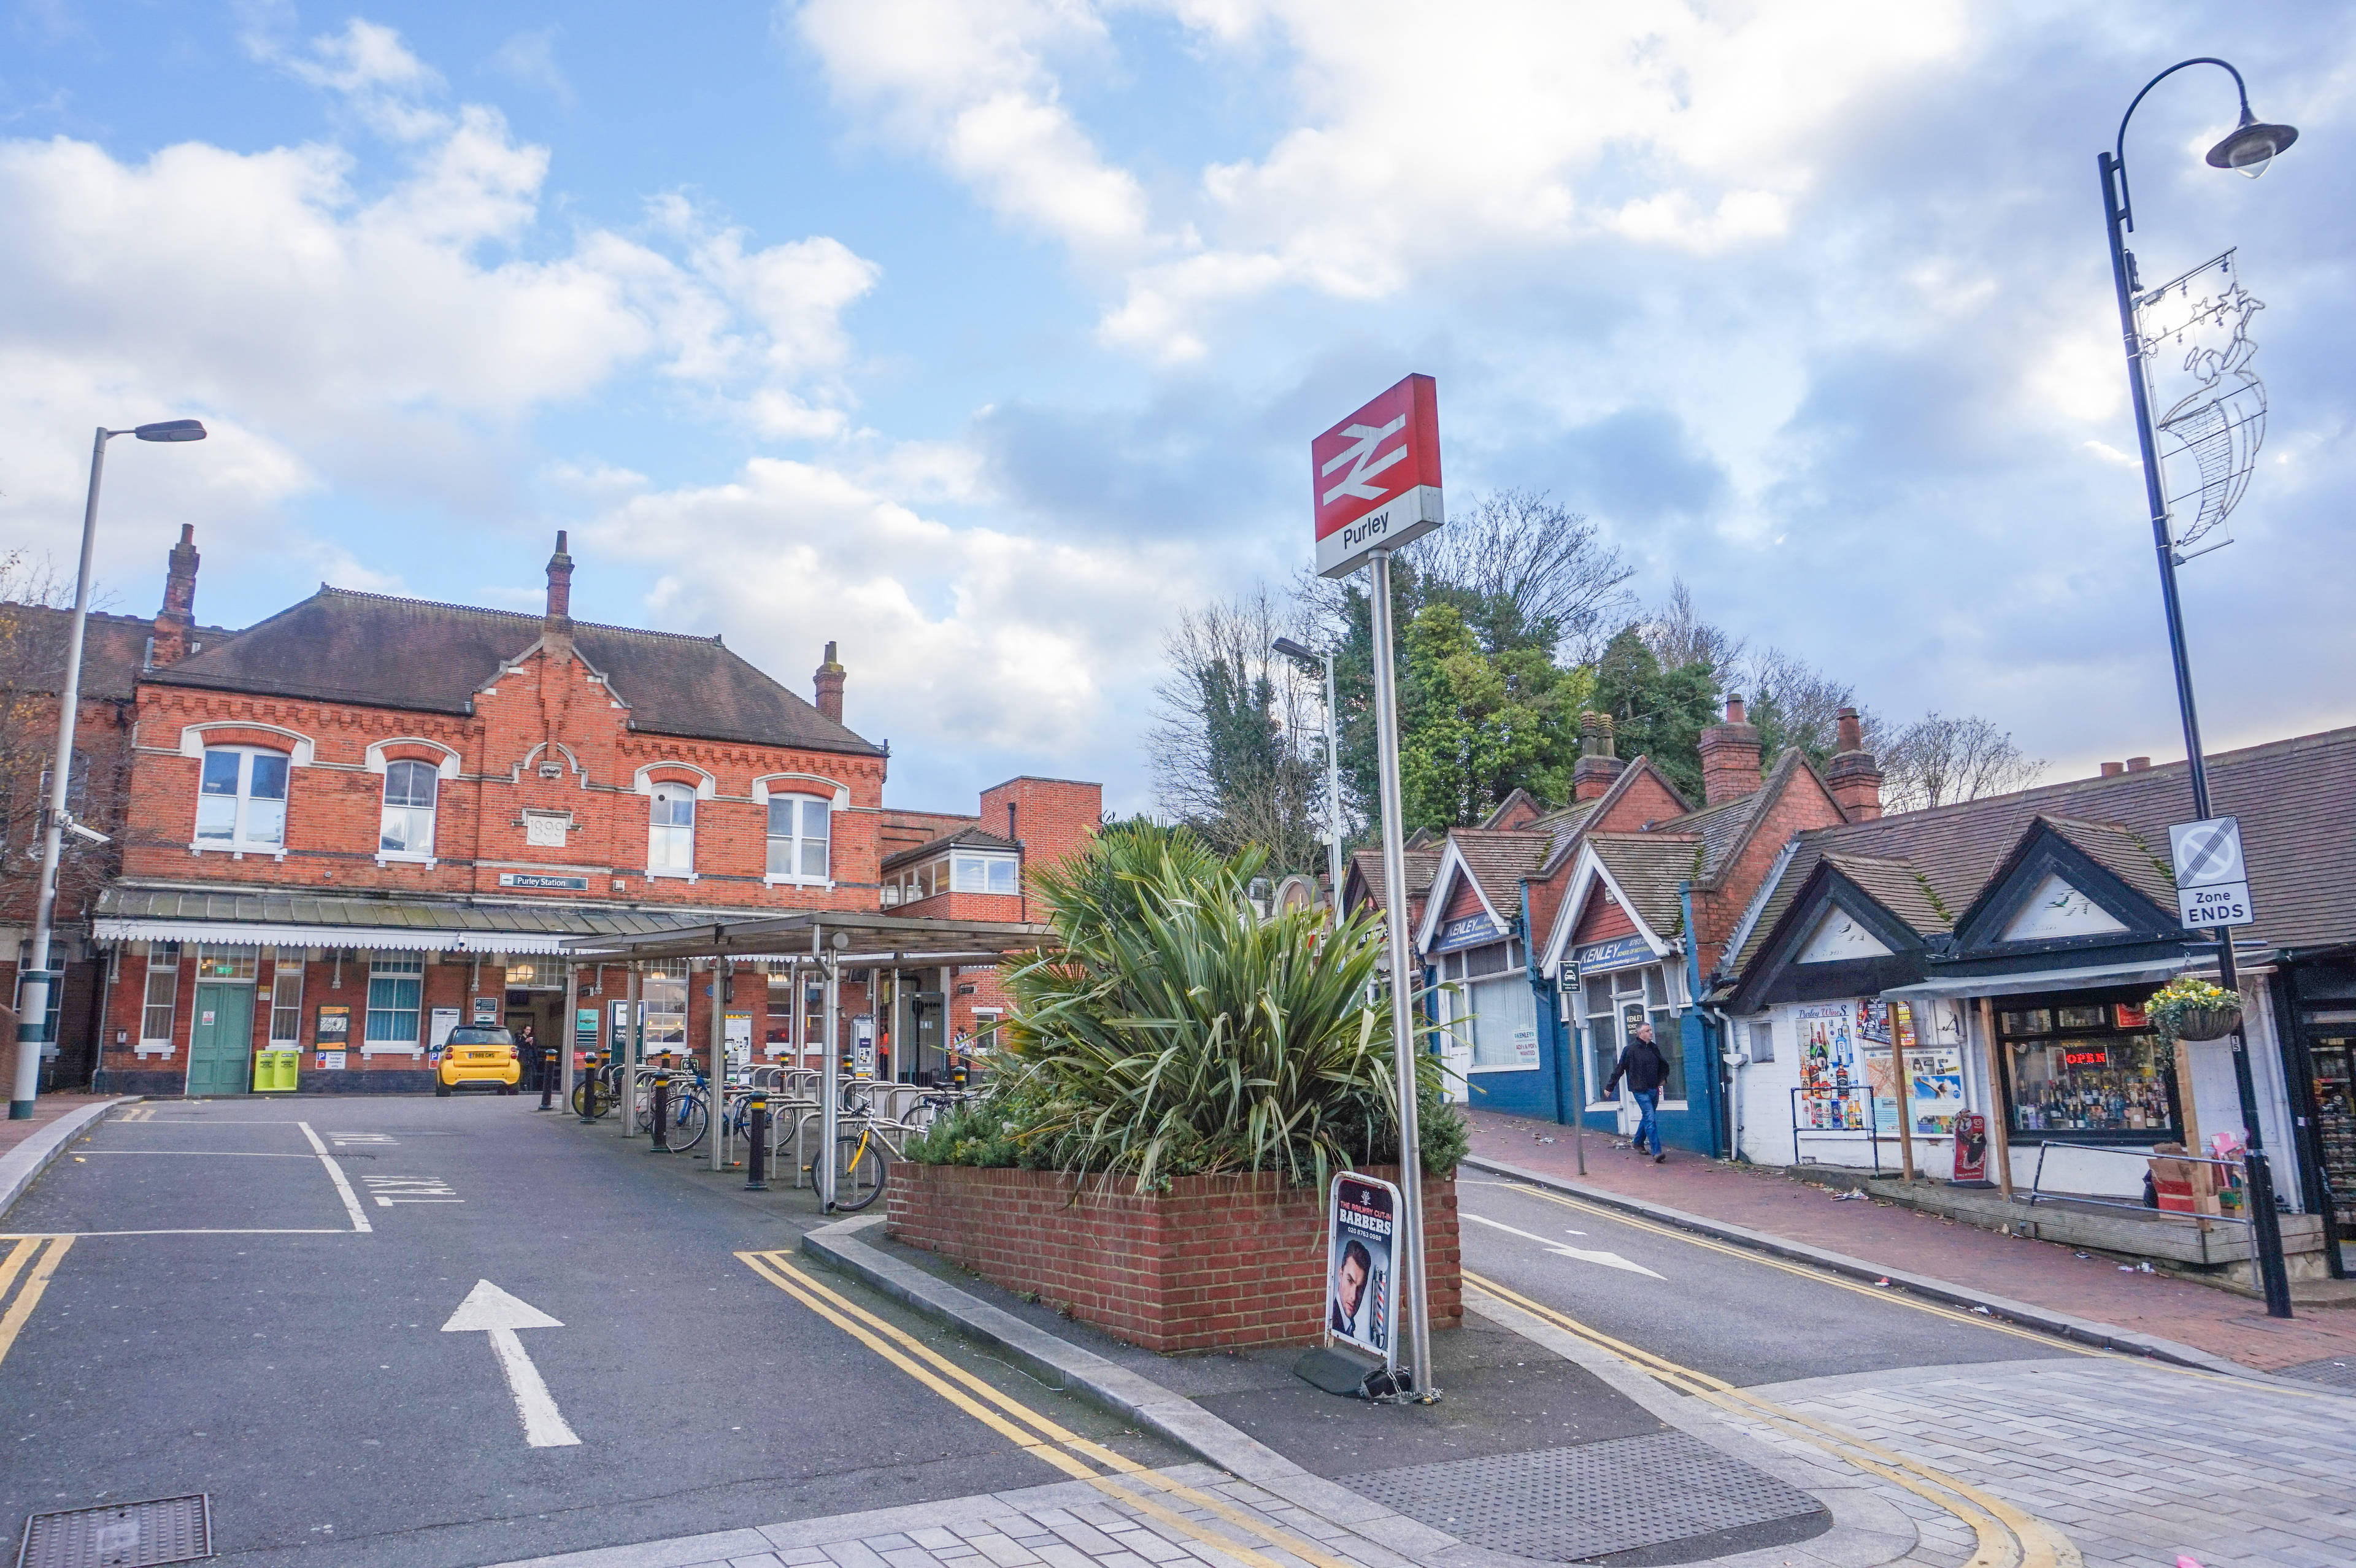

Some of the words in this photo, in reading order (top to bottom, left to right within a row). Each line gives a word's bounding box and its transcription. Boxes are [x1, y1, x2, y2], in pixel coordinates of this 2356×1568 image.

[1344, 512, 1388, 550] Purley
[530, 820, 564, 836] 1899
[517, 877, 539, 886] Purley
[541, 878, 566, 886] Station
[2196, 893, 2231, 904] Zone
[2189, 904, 2244, 922] ENDS
[1447, 918, 1479, 937] KENLEY
[1580, 943, 1622, 964] KENLEY
[1799, 1009, 1820, 1019] Purley
[2066, 1052, 2106, 1064] OPEN
[1340, 1201, 1350, 1209] THE
[1352, 1203, 1373, 1215] RAILWAY
[1374, 1210, 1392, 1221] CUT-IN
[1339, 1209, 1392, 1236] BARBERS
[1357, 1229, 1369, 1238] 8763
